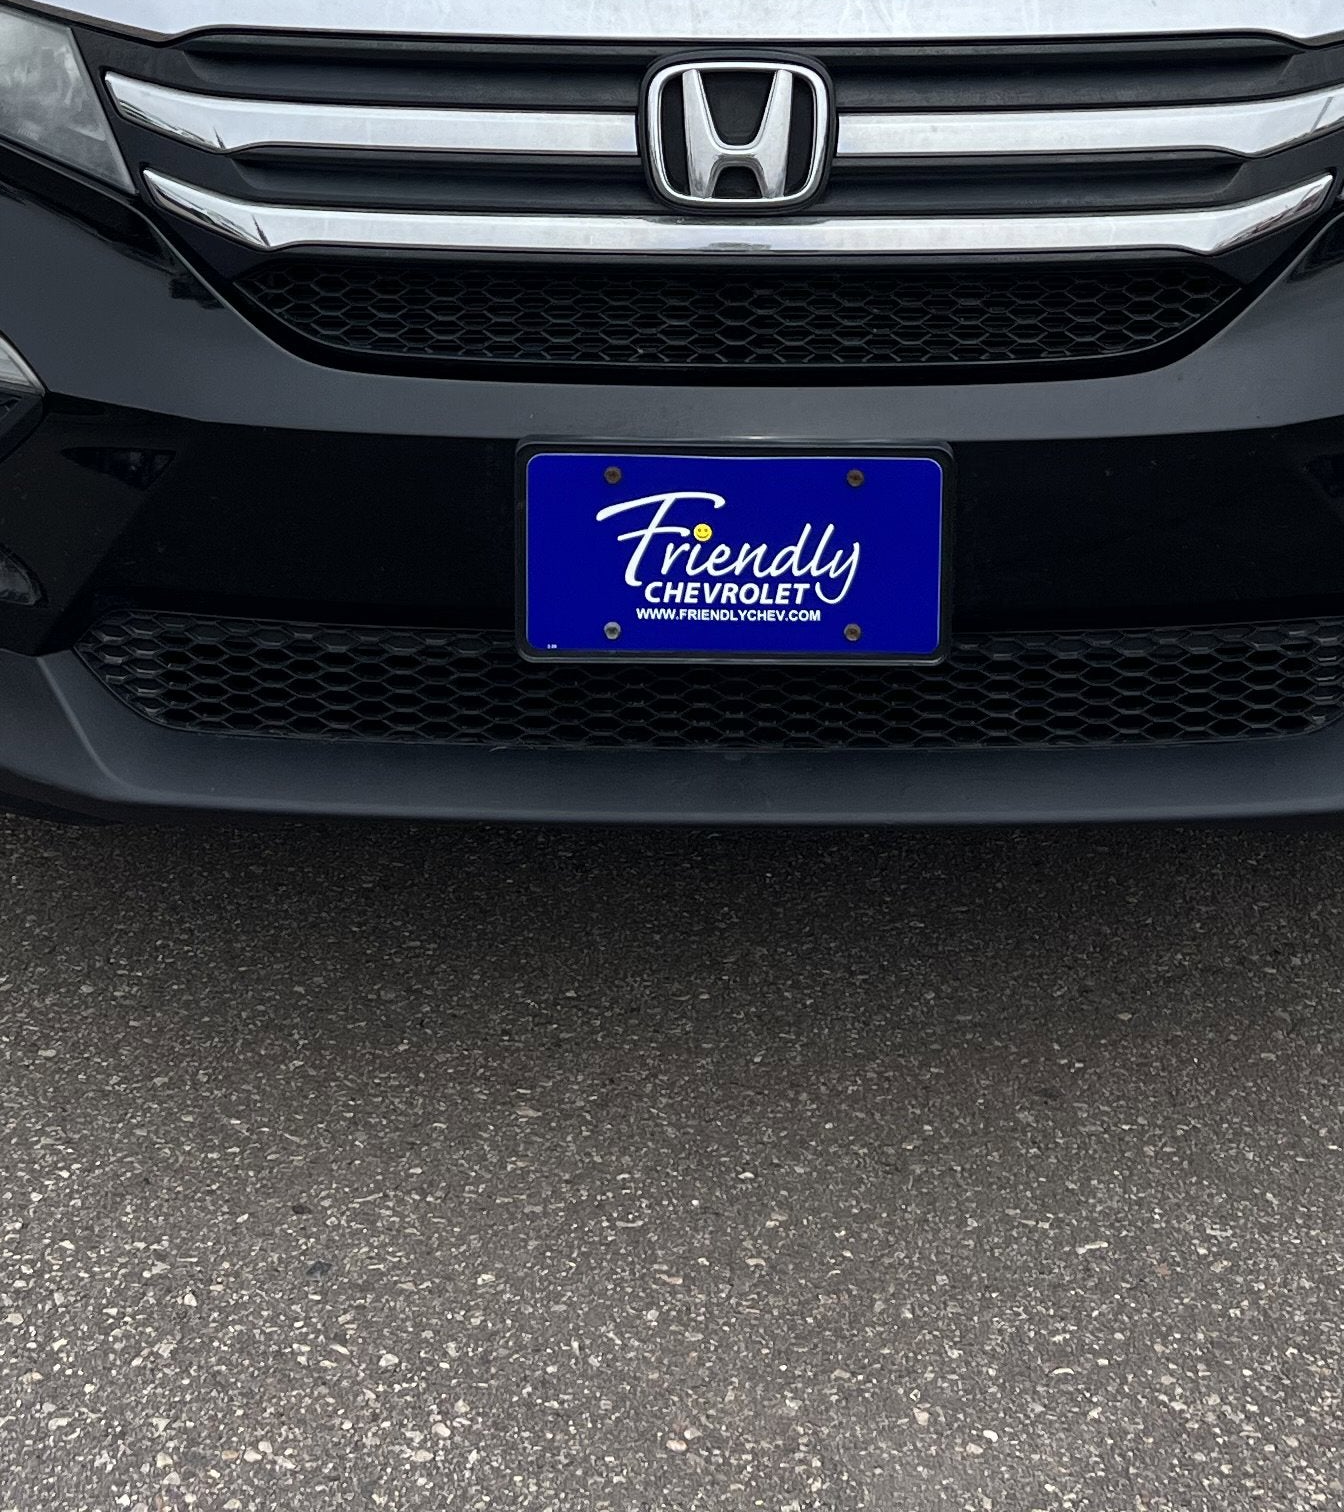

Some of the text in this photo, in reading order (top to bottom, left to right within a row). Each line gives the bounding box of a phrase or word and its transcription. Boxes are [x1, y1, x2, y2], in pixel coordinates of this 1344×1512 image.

[596, 491, 861, 604] Friendly
[644, 581, 811, 605] CHEVROLET
[636, 607, 821, 622] WWW.FRIENDLYCHEV.COM
